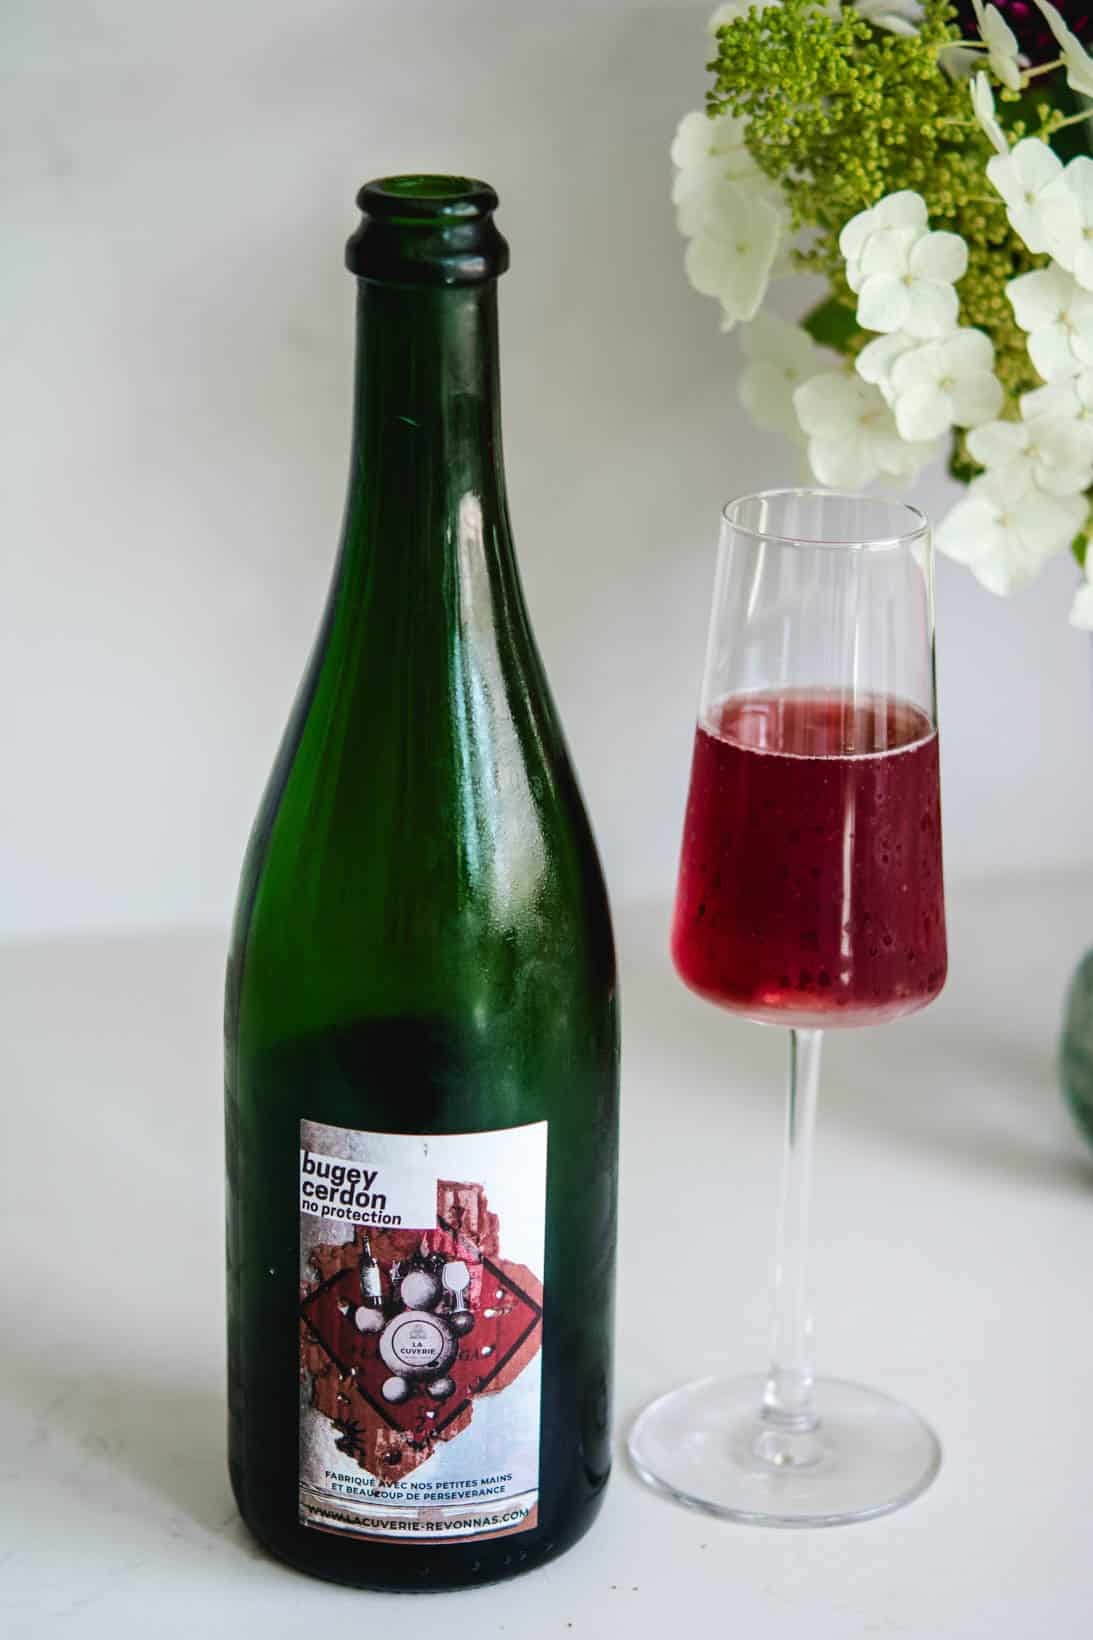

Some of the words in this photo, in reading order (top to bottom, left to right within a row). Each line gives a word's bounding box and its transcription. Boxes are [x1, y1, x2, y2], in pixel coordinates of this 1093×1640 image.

[302, 1152, 378, 1191] bugey
[302, 1181, 387, 1210] cerdon
[302, 1199, 319, 1213] no
[321, 1204, 402, 1225] protection
[400, 1347, 435, 1355] CUVERIE
[331, 1483, 343, 1491] ET
[346, 1486, 404, 1500] BEAUCOUP
[406, 1492, 420, 1500] DE
[424, 1486, 505, 1501] PERSEVERANCE
[379, 1481, 408, 1489] AVEC
[411, 1482, 433, 1490] NOS
[436, 1480, 478, 1490] PETITES
[480, 1473, 513, 1485] MAINS
